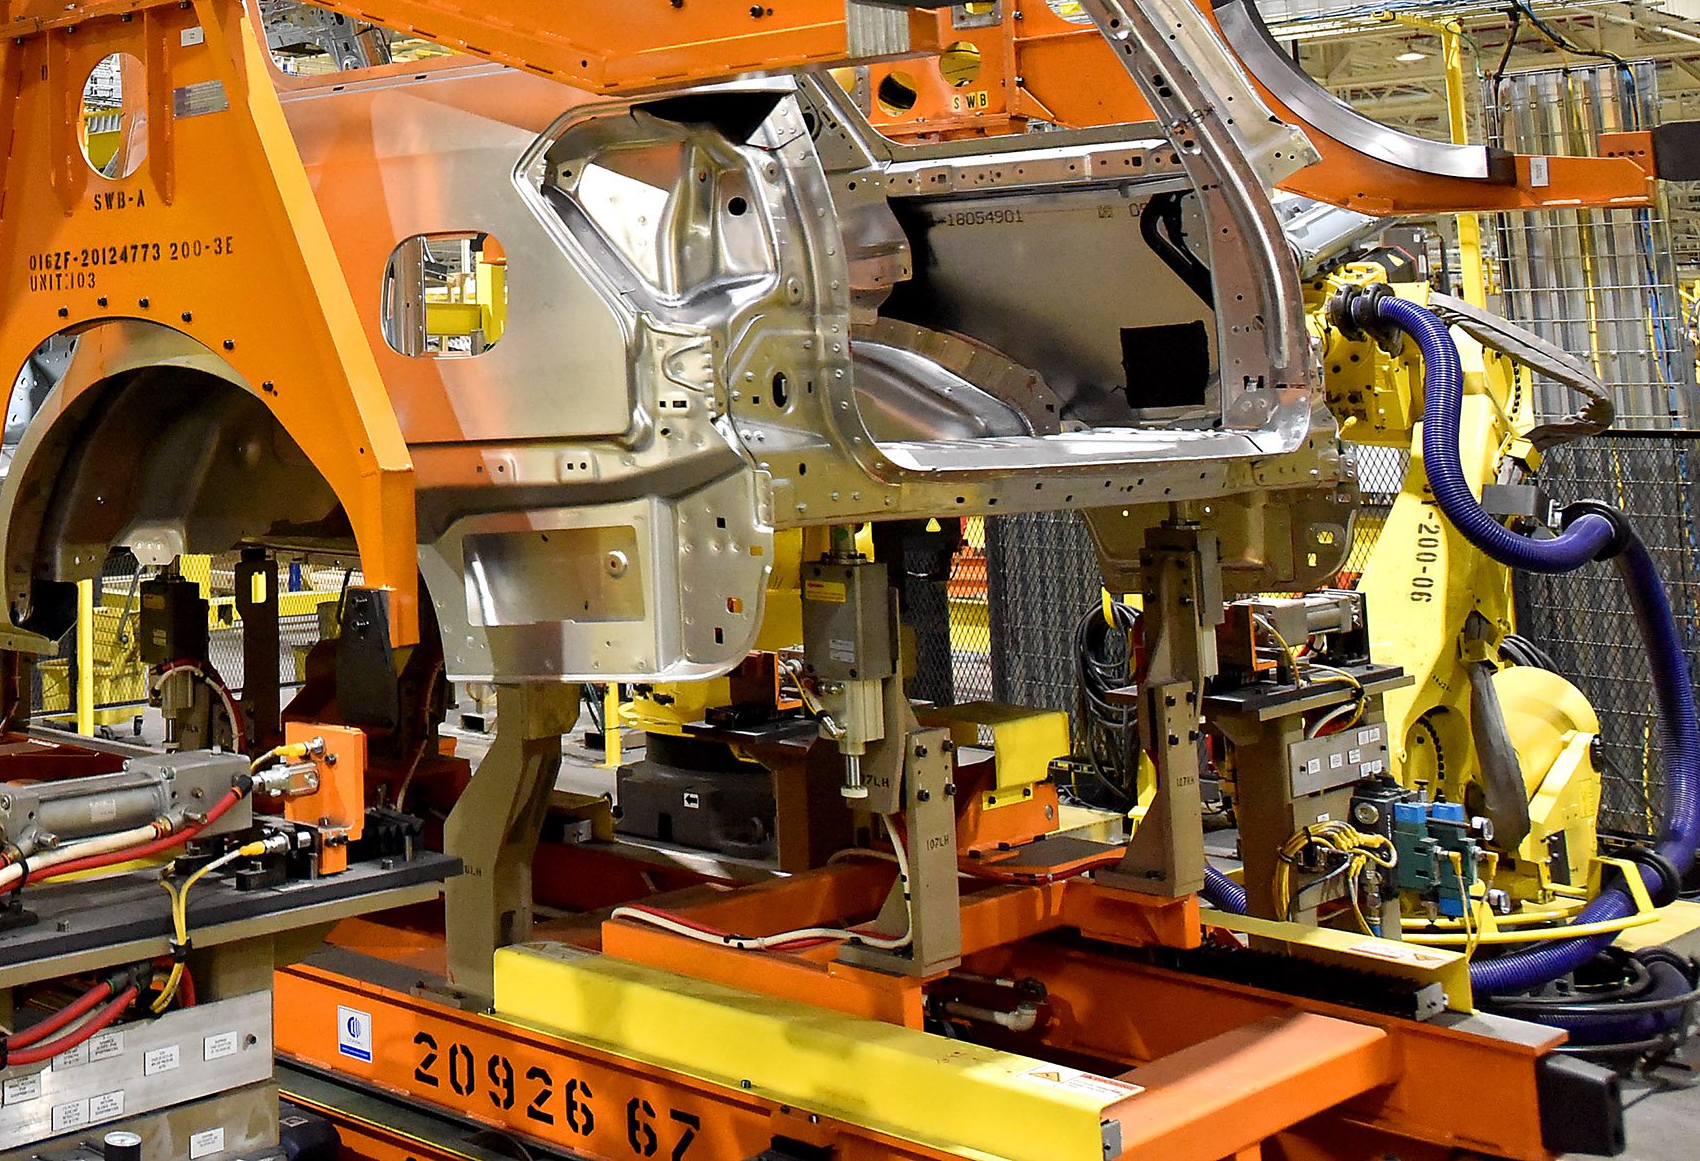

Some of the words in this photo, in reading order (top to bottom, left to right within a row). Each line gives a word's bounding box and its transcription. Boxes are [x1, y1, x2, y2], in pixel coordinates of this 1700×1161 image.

[93, 189, 146, 211] SWB-A
[29, 242, 161, 271] 016ZF-20124773
[169, 236, 234, 261] 200-3E
[30, 272, 97, 293] UNIT:103
[926, 834, 950, 851] 107LH
[413, 1031, 596, 1138] 20926
[626, 1096, 701, 1161] 67
